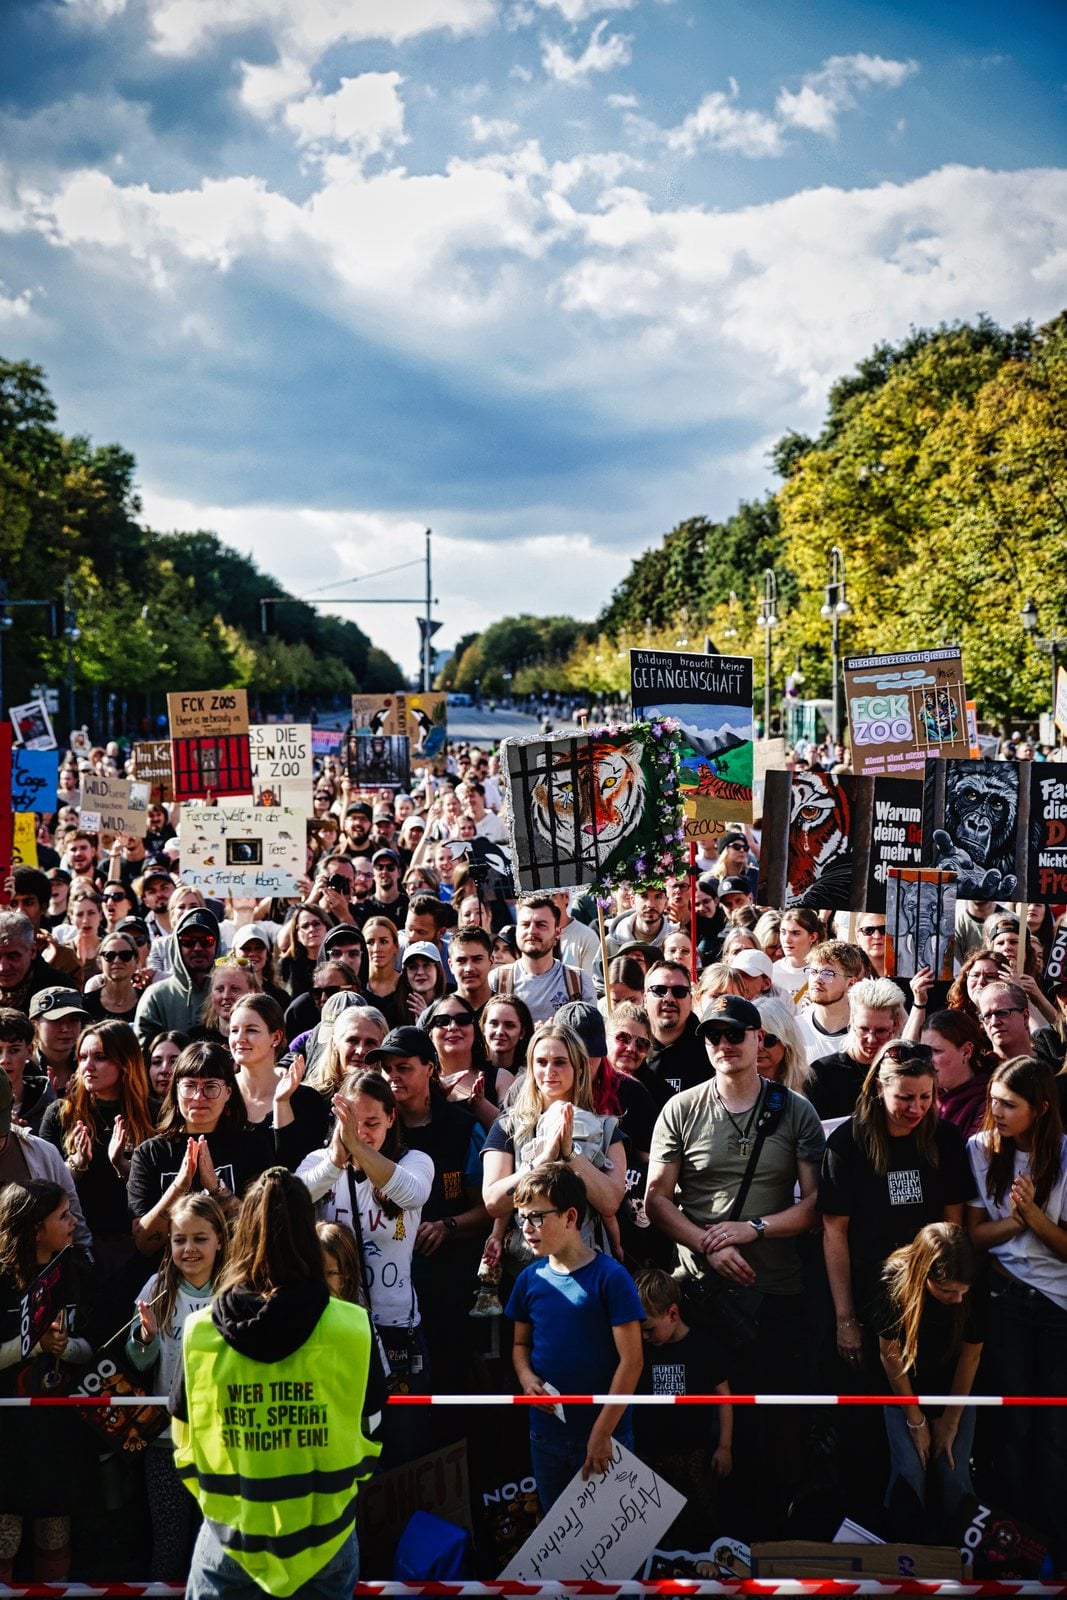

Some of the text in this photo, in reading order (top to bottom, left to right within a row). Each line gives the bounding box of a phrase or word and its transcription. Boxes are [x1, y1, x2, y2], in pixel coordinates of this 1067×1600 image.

[637, 653, 746, 672] Bildung braucht keine
[633, 667, 743, 694] GEFANGENSCHAFT
[181, 695, 236, 712] FCK ZOOS
[852, 697, 909, 721] FCK
[248, 728, 264, 743] SS
[275, 727, 297, 743] DIE
[854, 719, 912, 745] ZOO
[249, 744, 306, 761] FEN AUS
[16, 768, 49, 793] Cage
[270, 761, 301, 777] ZOO
[12, 789, 37, 811] pty
[1039, 778, 1067, 801] Fa
[875, 800, 922, 823] Warum
[873, 821, 907, 845] deine
[879, 843, 912, 862] mehr
[873, 861, 894, 884] al
[1039, 868, 1067, 895] Fre
[227, 1381, 315, 1404] WER TIERE
[222, 1404, 329, 1430] IEBT, SPERRT
[244, 1428, 293, 1452] NICHT
[297, 1427, 329, 1450] EIN!
[576, 1480, 596, 1510] die
[579, 1471, 662, 1582] Artgerecht
